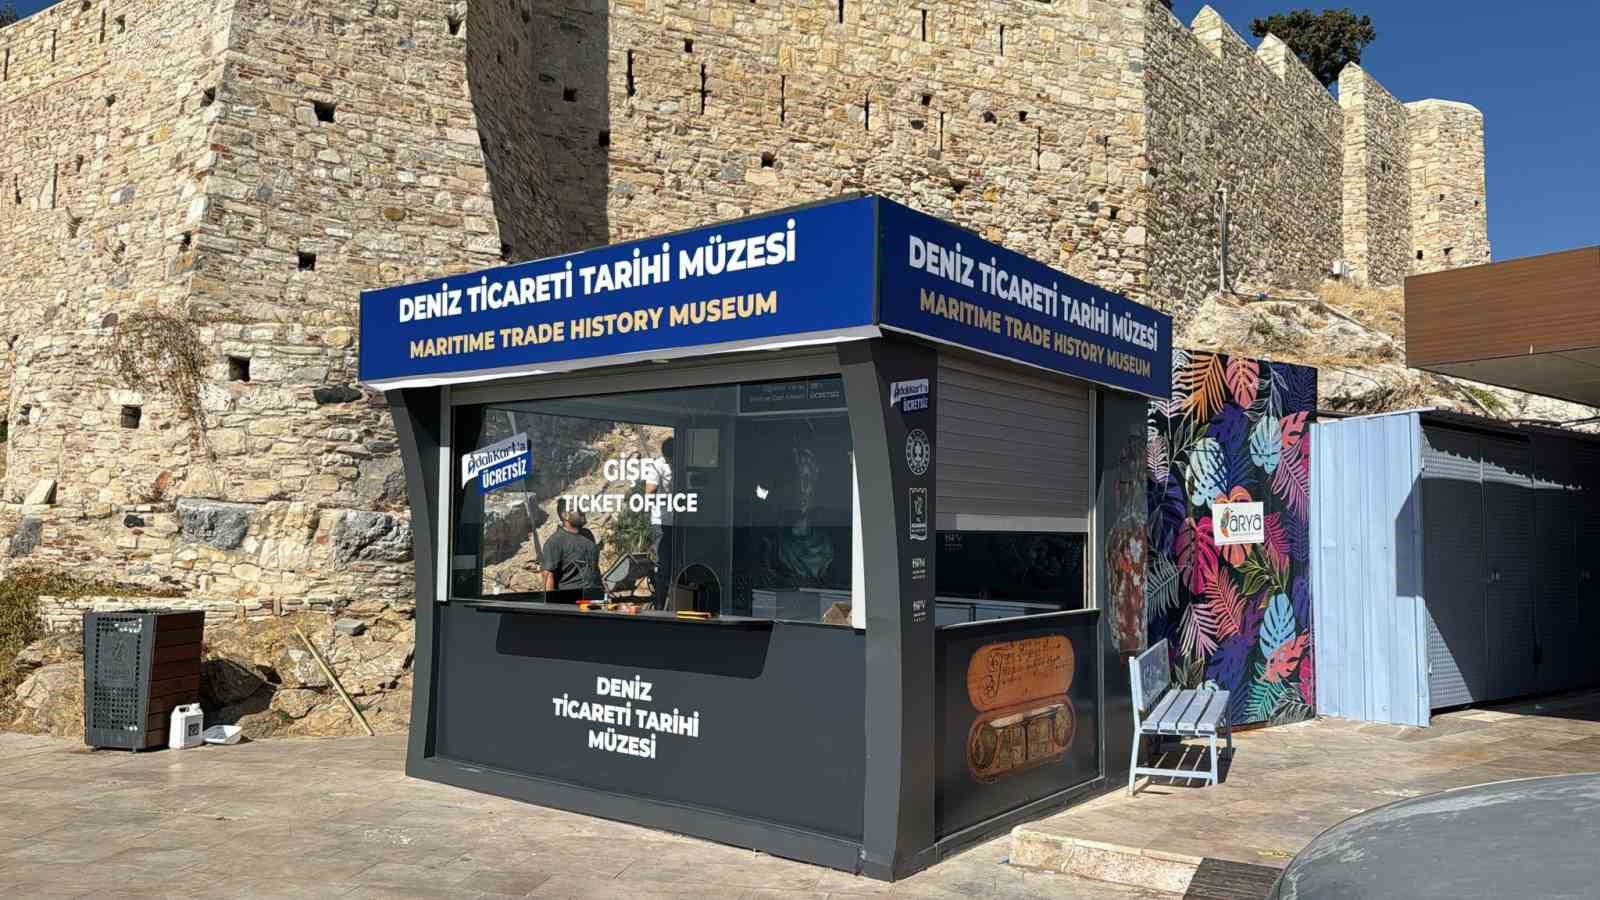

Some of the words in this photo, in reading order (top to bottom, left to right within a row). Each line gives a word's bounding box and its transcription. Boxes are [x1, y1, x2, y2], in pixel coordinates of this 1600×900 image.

[399, 283, 462, 323] DENİZ
[467, 260, 573, 314] TİCARETİ
[579, 242, 670, 294] TARİHİ
[679, 218, 796, 279] MÜZESİ
[909, 235, 975, 288] DENİZ
[978, 256, 1058, 317] TİCARETİ
[1060, 295, 1109, 336] TARİHİ
[1112, 312, 1158, 352] MÜZESİ
[410, 331, 495, 359] MARITIME
[499, 321, 565, 347] TRADE
[570, 307, 664, 340] HISTORY
[669, 291, 778, 327] MUSEUM
[920, 288, 1001, 334] MARITIME
[1004, 314, 1051, 350] TRADE
[1054, 334, 1105, 365] HISTORY
[1107, 350, 1152, 379] MUSEUM
[482, 457, 527, 488] ÜCRETSİZ
[603, 454, 656, 487] GİŞE
[562, 494, 625, 512] TICKET
[629, 493, 698, 512] OFFICE
[596, 674, 653, 702] DENİZ
[552, 692, 632, 727] TİCARETİ
[635, 706, 700, 738] TARİHİ
[588, 726, 657, 759] MÜZESİ
